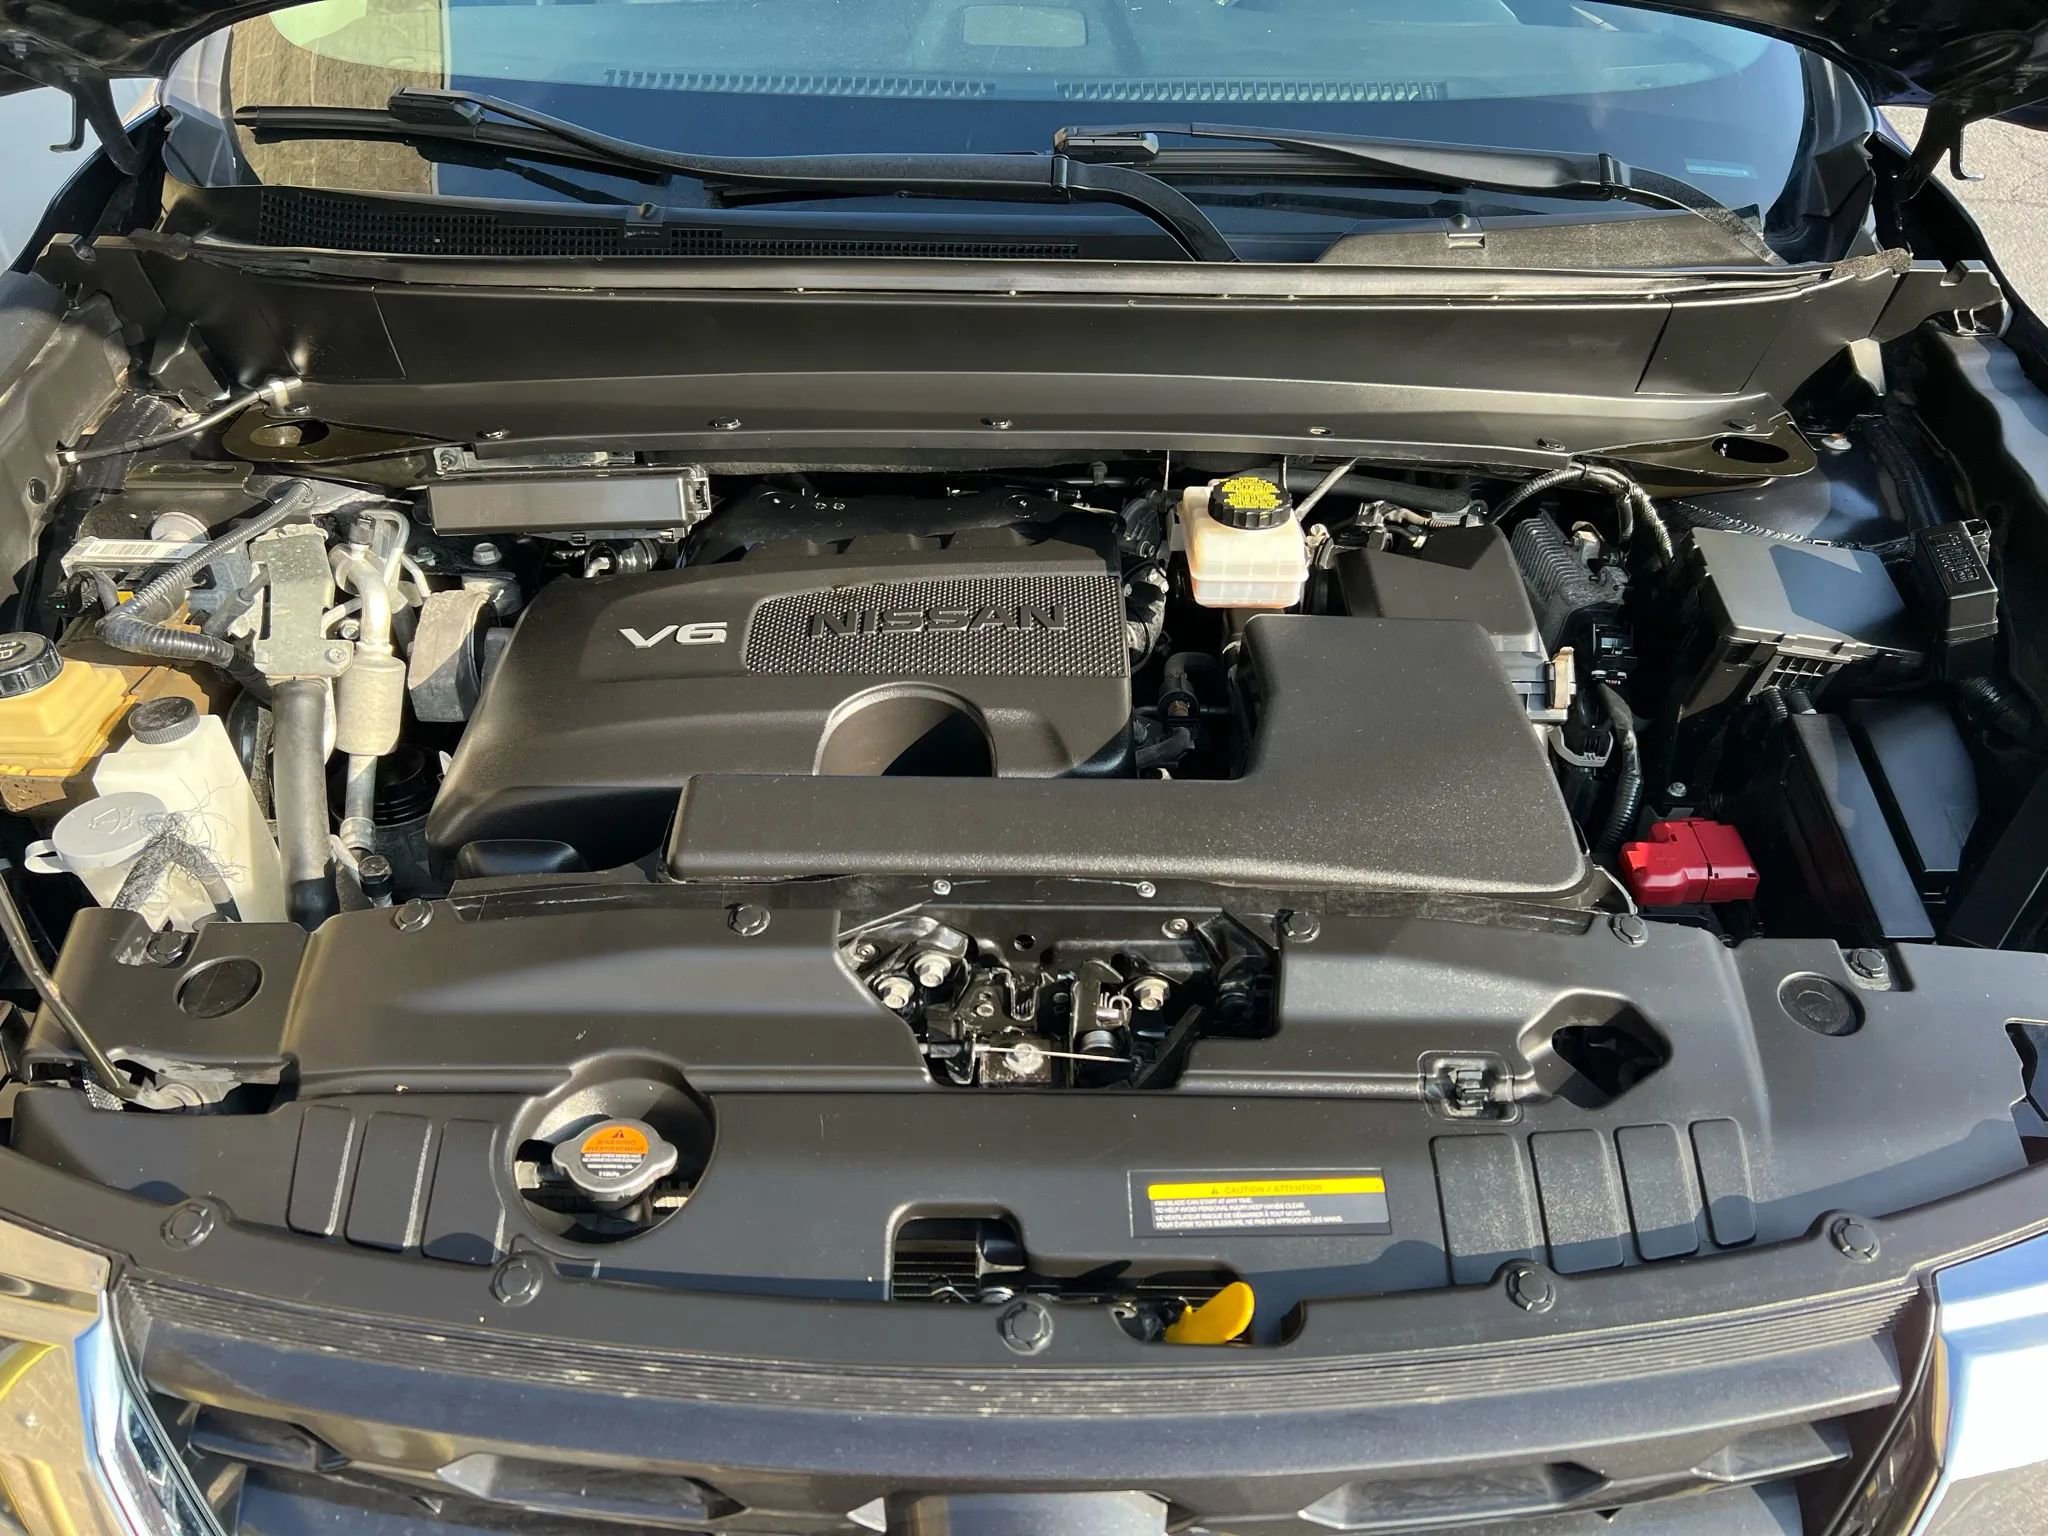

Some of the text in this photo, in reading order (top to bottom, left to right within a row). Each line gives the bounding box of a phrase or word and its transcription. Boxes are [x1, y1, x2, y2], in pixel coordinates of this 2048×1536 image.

[619, 622, 728, 648] V6
[809, 605, 1068, 639] NISSAN
[1224, 1186, 1265, 1194] CAUTION
[1274, 1184, 1323, 1193] ATTENTION
